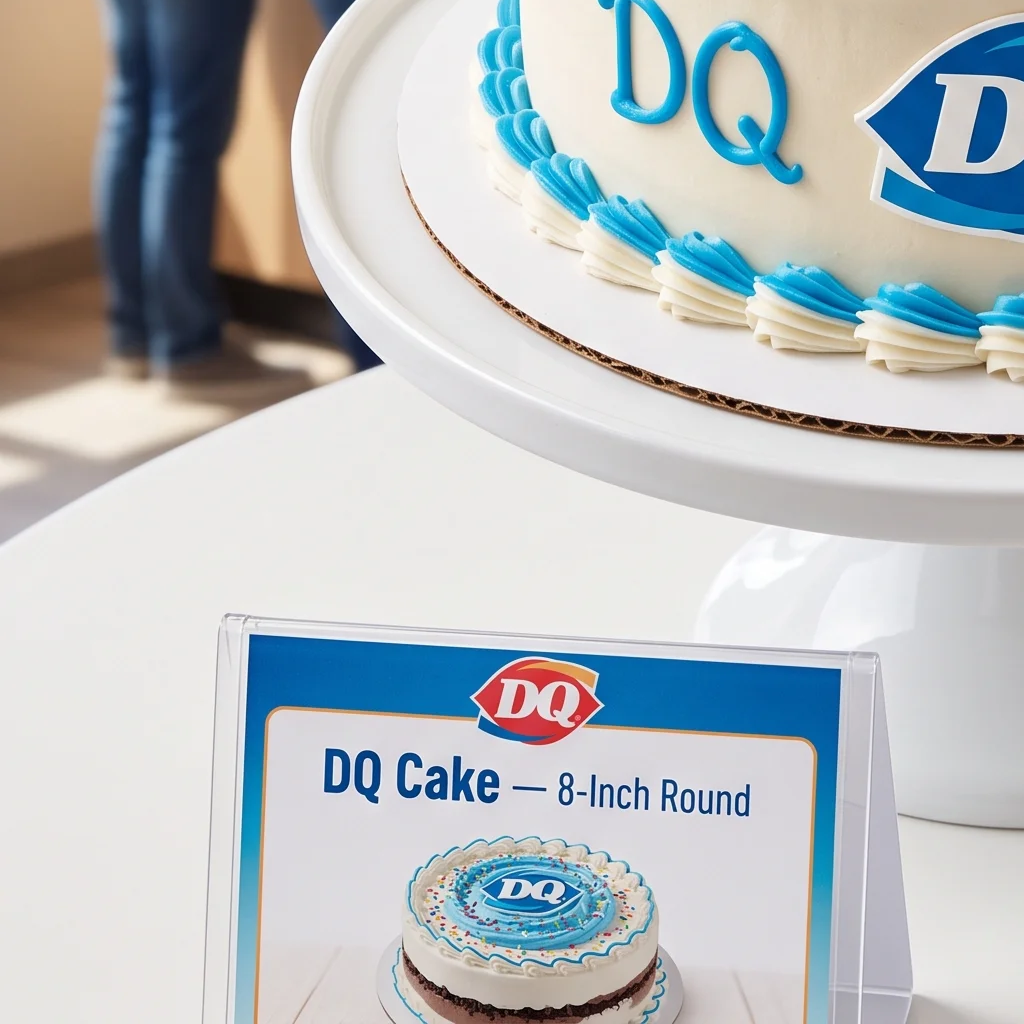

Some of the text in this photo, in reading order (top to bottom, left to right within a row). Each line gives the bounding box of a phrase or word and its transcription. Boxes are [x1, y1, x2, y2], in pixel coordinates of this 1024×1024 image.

[323, 747, 382, 804] DQ
[397, 752, 500, 804] Cake
[557, 772, 650, 811] 8-Inch
[661, 778, 751, 817] Round
[497, 878, 566, 905] DQ
